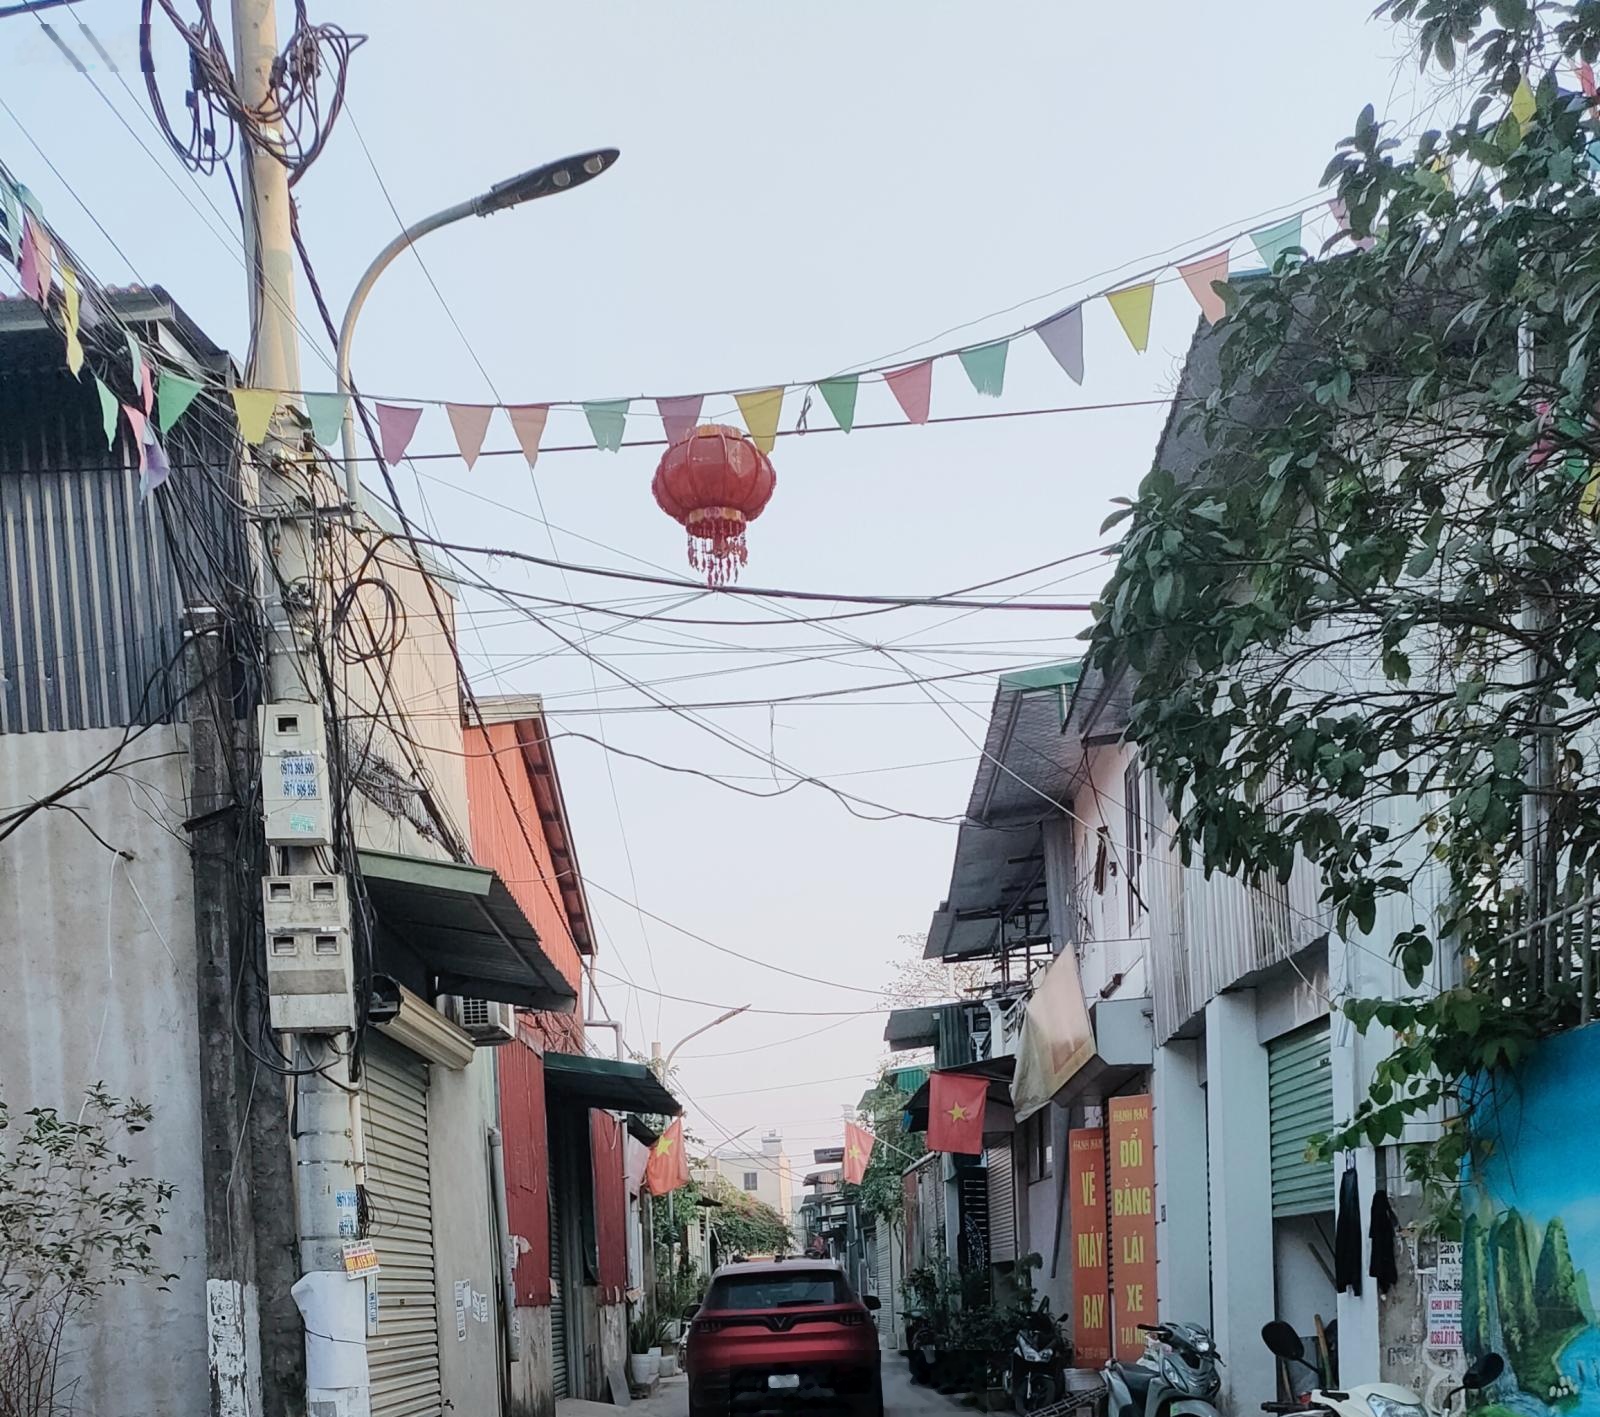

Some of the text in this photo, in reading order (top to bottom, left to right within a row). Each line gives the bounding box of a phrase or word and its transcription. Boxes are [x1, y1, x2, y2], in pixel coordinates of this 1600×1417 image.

[1120, 1127, 1143, 1168] ĐỔI
[1081, 1163, 1096, 1207] VÉ
[1078, 1226, 1103, 1268] MÁY
[1123, 1230, 1144, 1265] LÁI
[1083, 1294, 1104, 1329] BAY
[1126, 1284, 1144, 1313] XE
